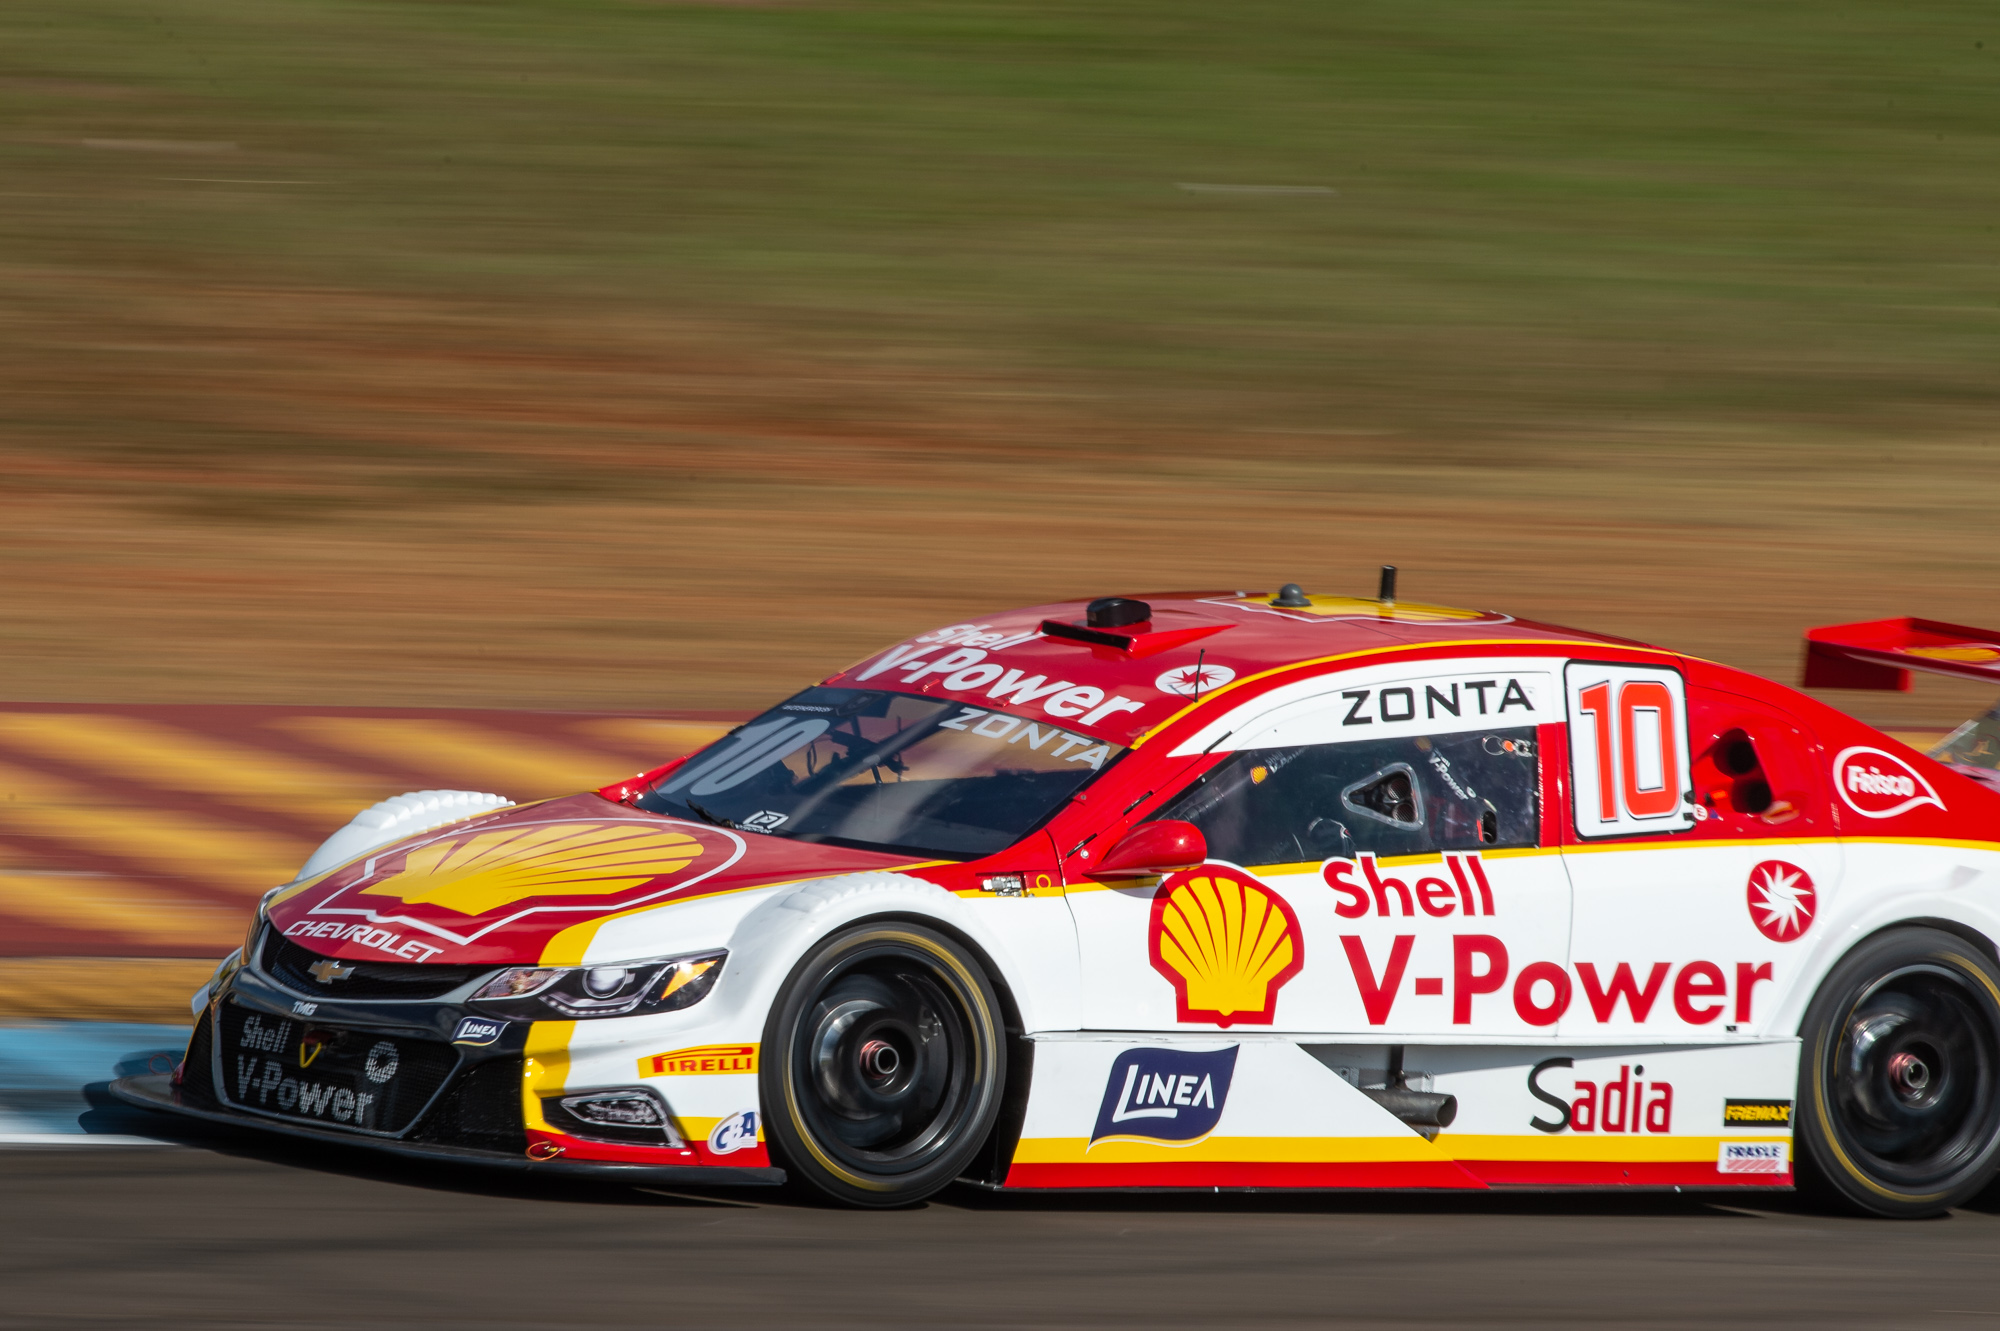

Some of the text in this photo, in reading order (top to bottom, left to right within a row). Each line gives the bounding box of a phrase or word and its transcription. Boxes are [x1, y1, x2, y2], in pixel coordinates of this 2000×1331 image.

[915, 624, 1049, 651] Shell
[855, 644, 1146, 726] V-Power
[1341, 678, 1535, 726] ZONTA
[656, 716, 831, 796] 10
[938, 706, 1112, 771] ZONTA
[1579, 679, 1681, 823] 10
[1846, 765, 1916, 797] Frisco
[1323, 856, 1495, 918] Shell
[282, 920, 444, 963] CHEVROLET
[1339, 934, 1773, 1026] V-Power
[291, 1001, 317, 1016] TMG
[457, 1021, 496, 1038] LINEA
[240, 1014, 291, 1054] Shell
[652, 1046, 753, 1073] PIRELLI
[237, 1054, 373, 1125] V-Power
[1112, 1064, 1214, 1123] LINEA
[1527, 1057, 1672, 1132] Sadia
[1725, 1105, 1792, 1121] FREMAX
[715, 1111, 755, 1150] CBA
